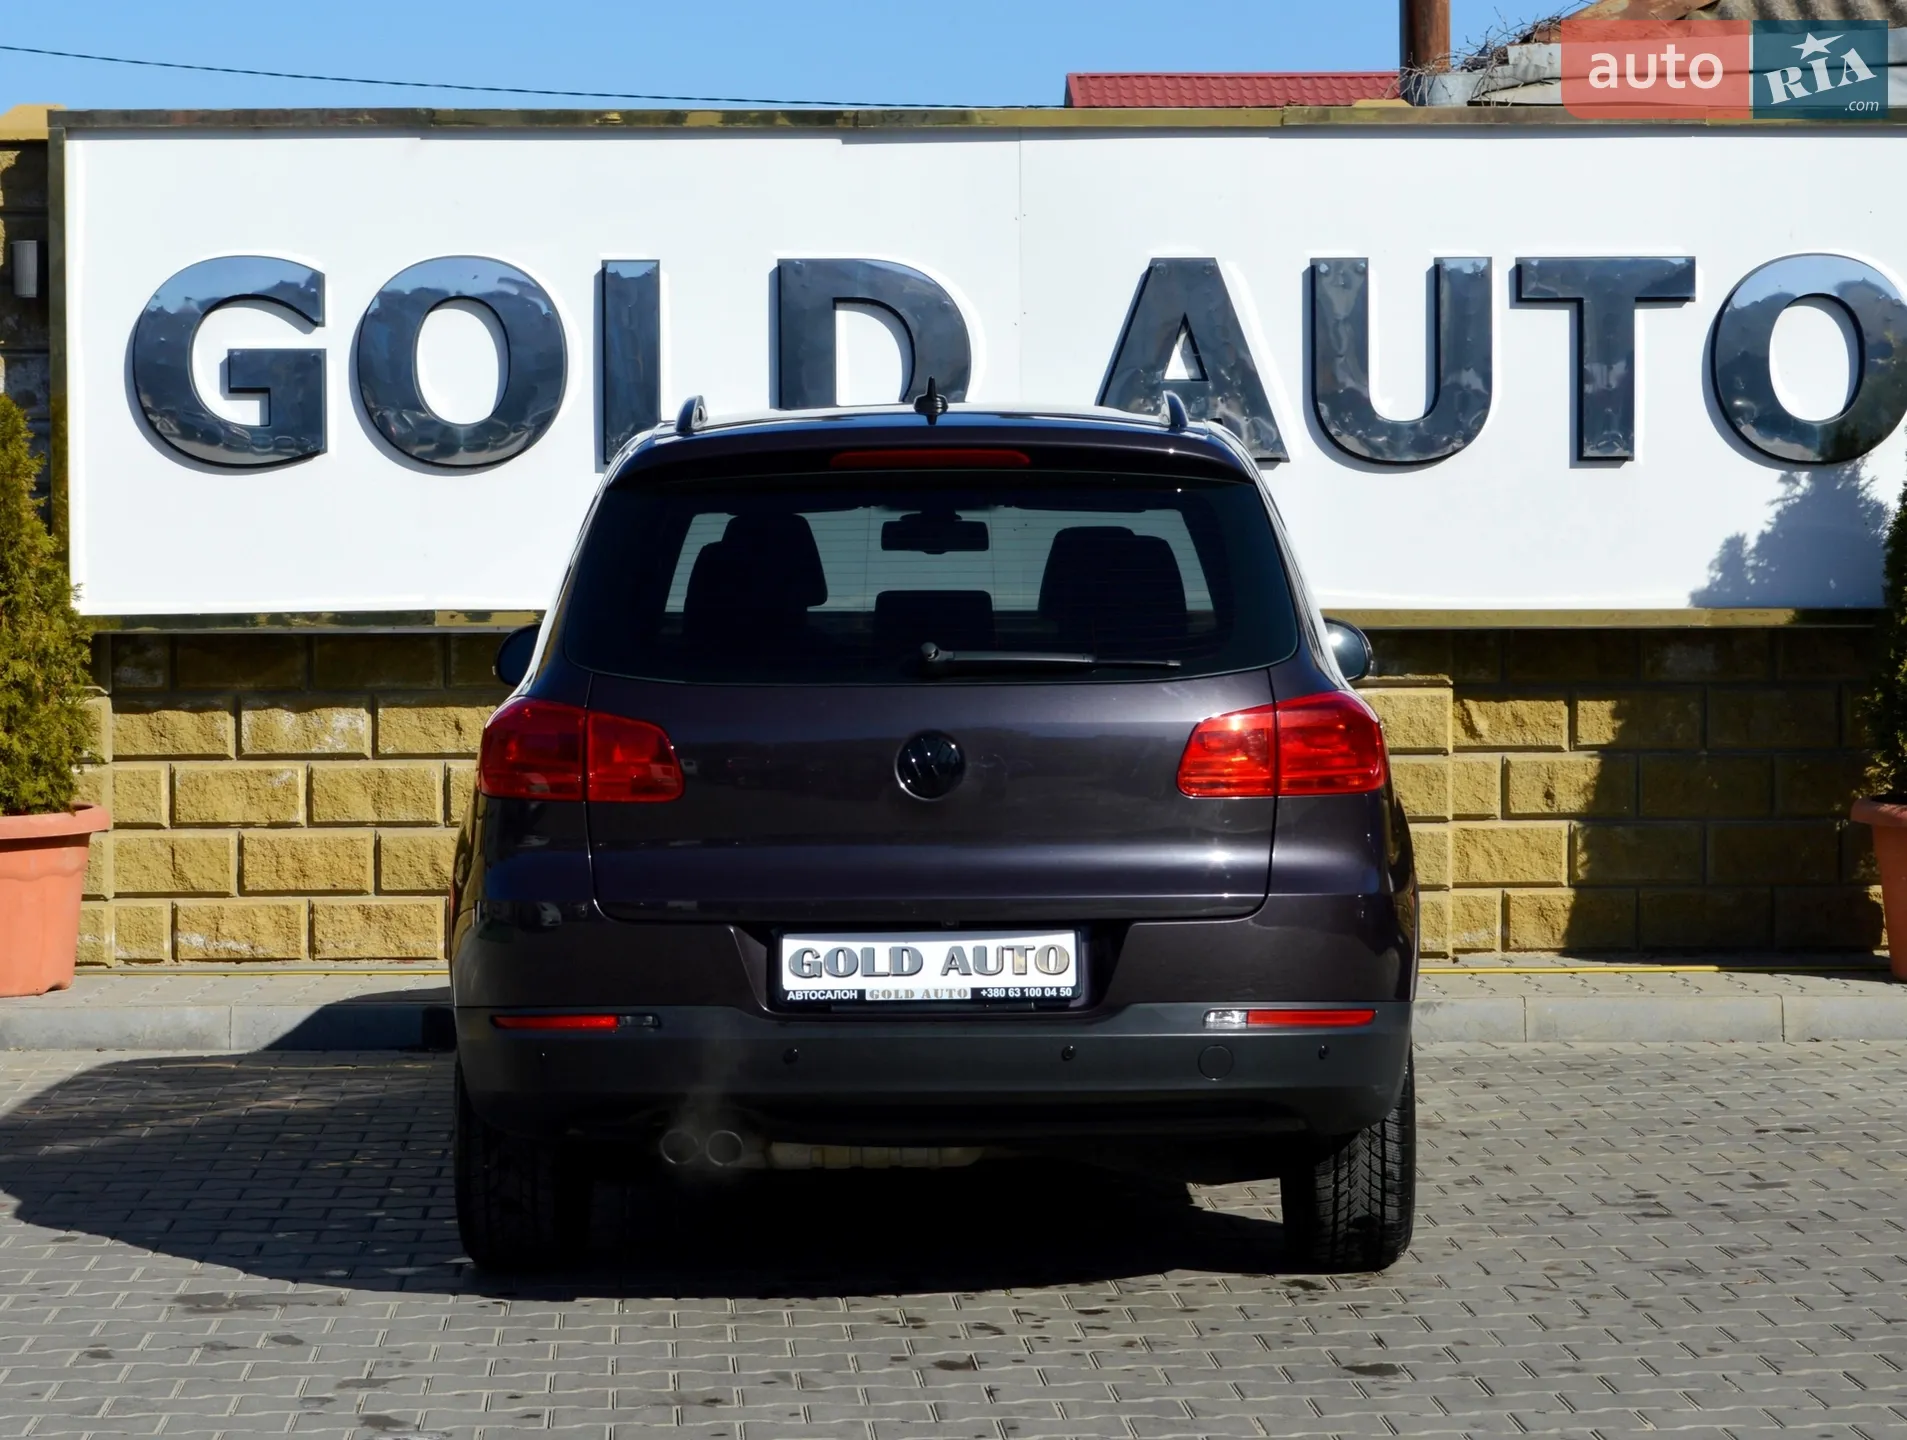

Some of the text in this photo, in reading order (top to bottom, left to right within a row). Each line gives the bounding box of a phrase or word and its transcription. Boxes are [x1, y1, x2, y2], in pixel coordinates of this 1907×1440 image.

[1094, 253, 1907, 466] AUTO
[788, 943, 1071, 978] GOLD AUTO
[787, 990, 858, 1000] АВТОСАЛОН
[869, 987, 969, 999] GOLD AUTO
[980, 987, 1073, 998] +380 63 100 04 50
